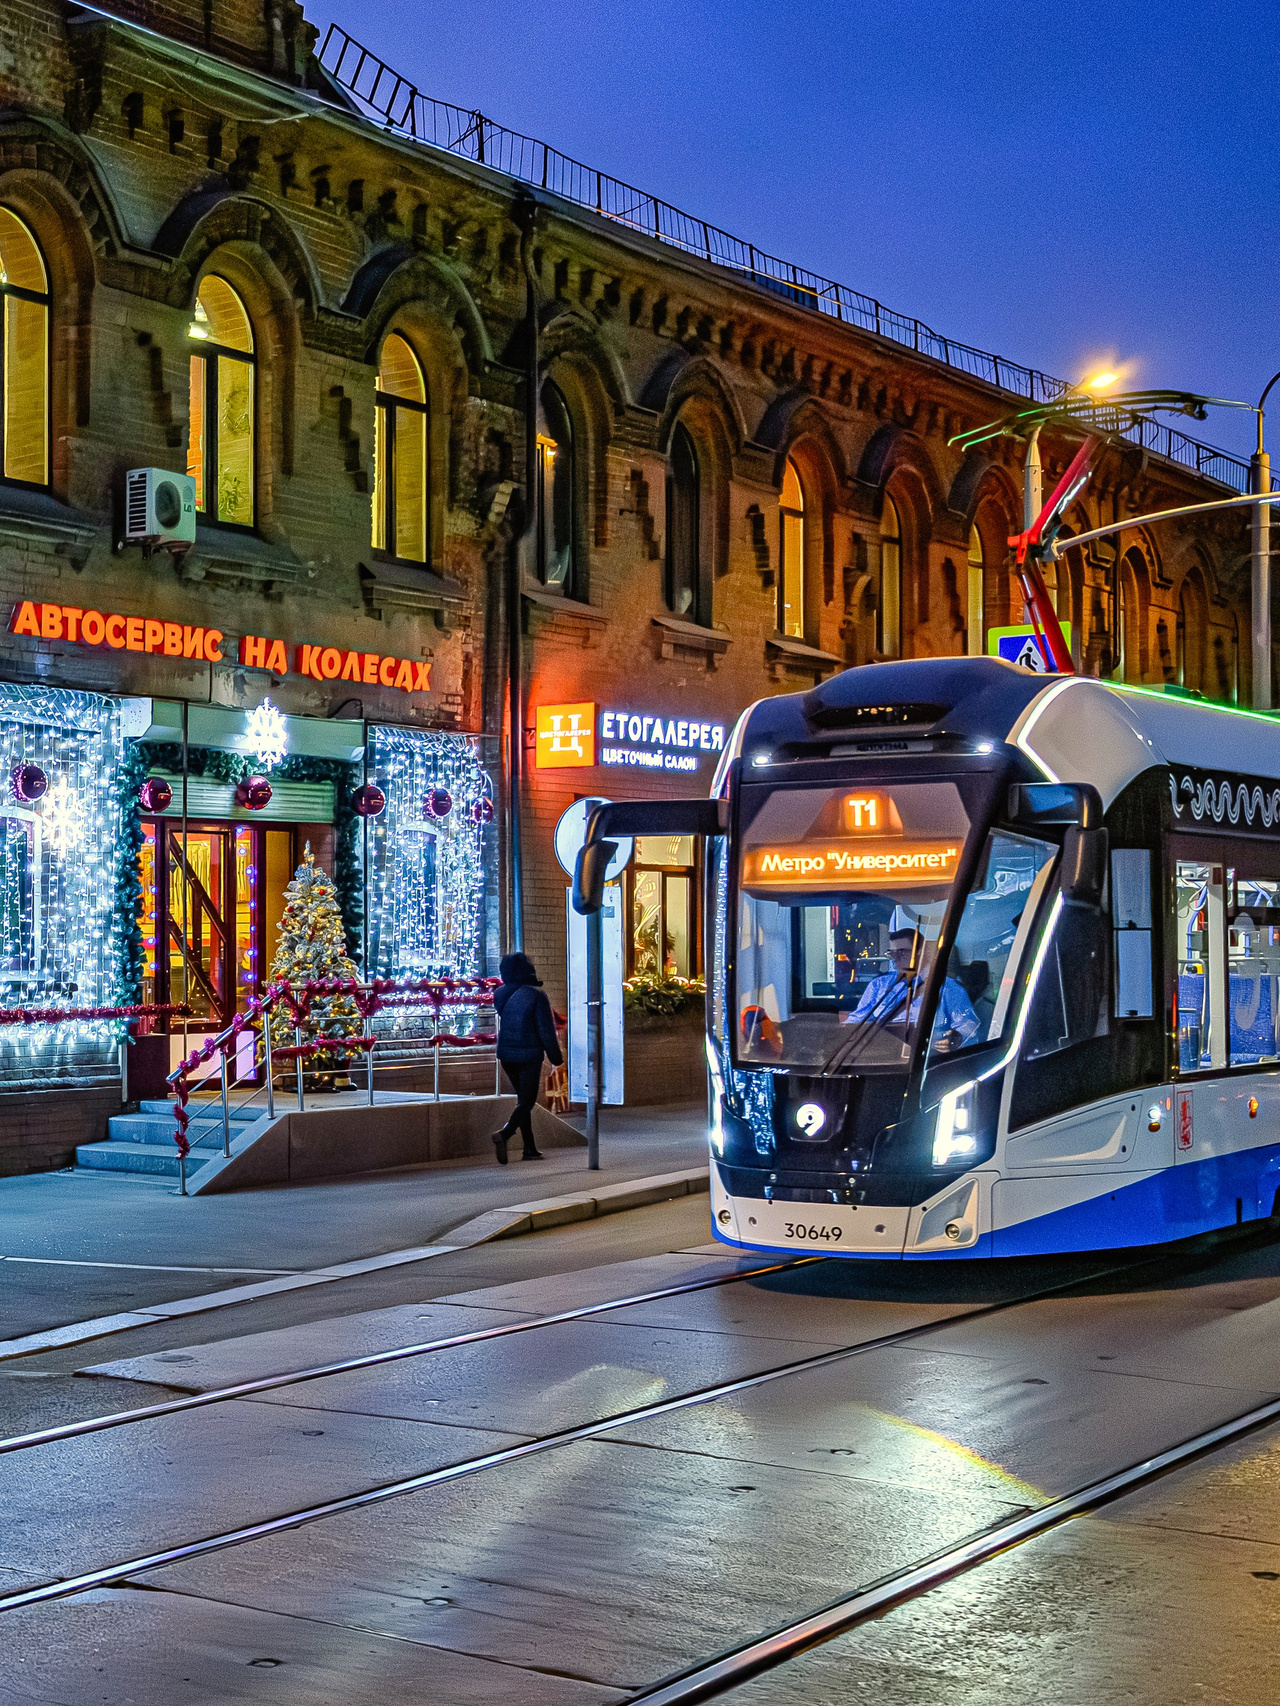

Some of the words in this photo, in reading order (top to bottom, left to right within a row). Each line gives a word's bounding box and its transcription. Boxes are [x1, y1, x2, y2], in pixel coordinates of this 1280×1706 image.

[12, 600, 224, 663] АВТОСЕРВИС
[244, 634, 288, 676] НА
[300, 643, 433, 693] КОЛЕСАХ
[602, 711, 724, 751] ЕТОГАЛЕРЕЯ
[602, 747, 664, 768] ЦВЕТОЧНЫЙ
[664, 754, 698, 771] САЛОН
[761, 853, 825, 875] Метро
[827, 848, 957, 872] "Университет"
[783, 1222, 843, 1242] 30649
